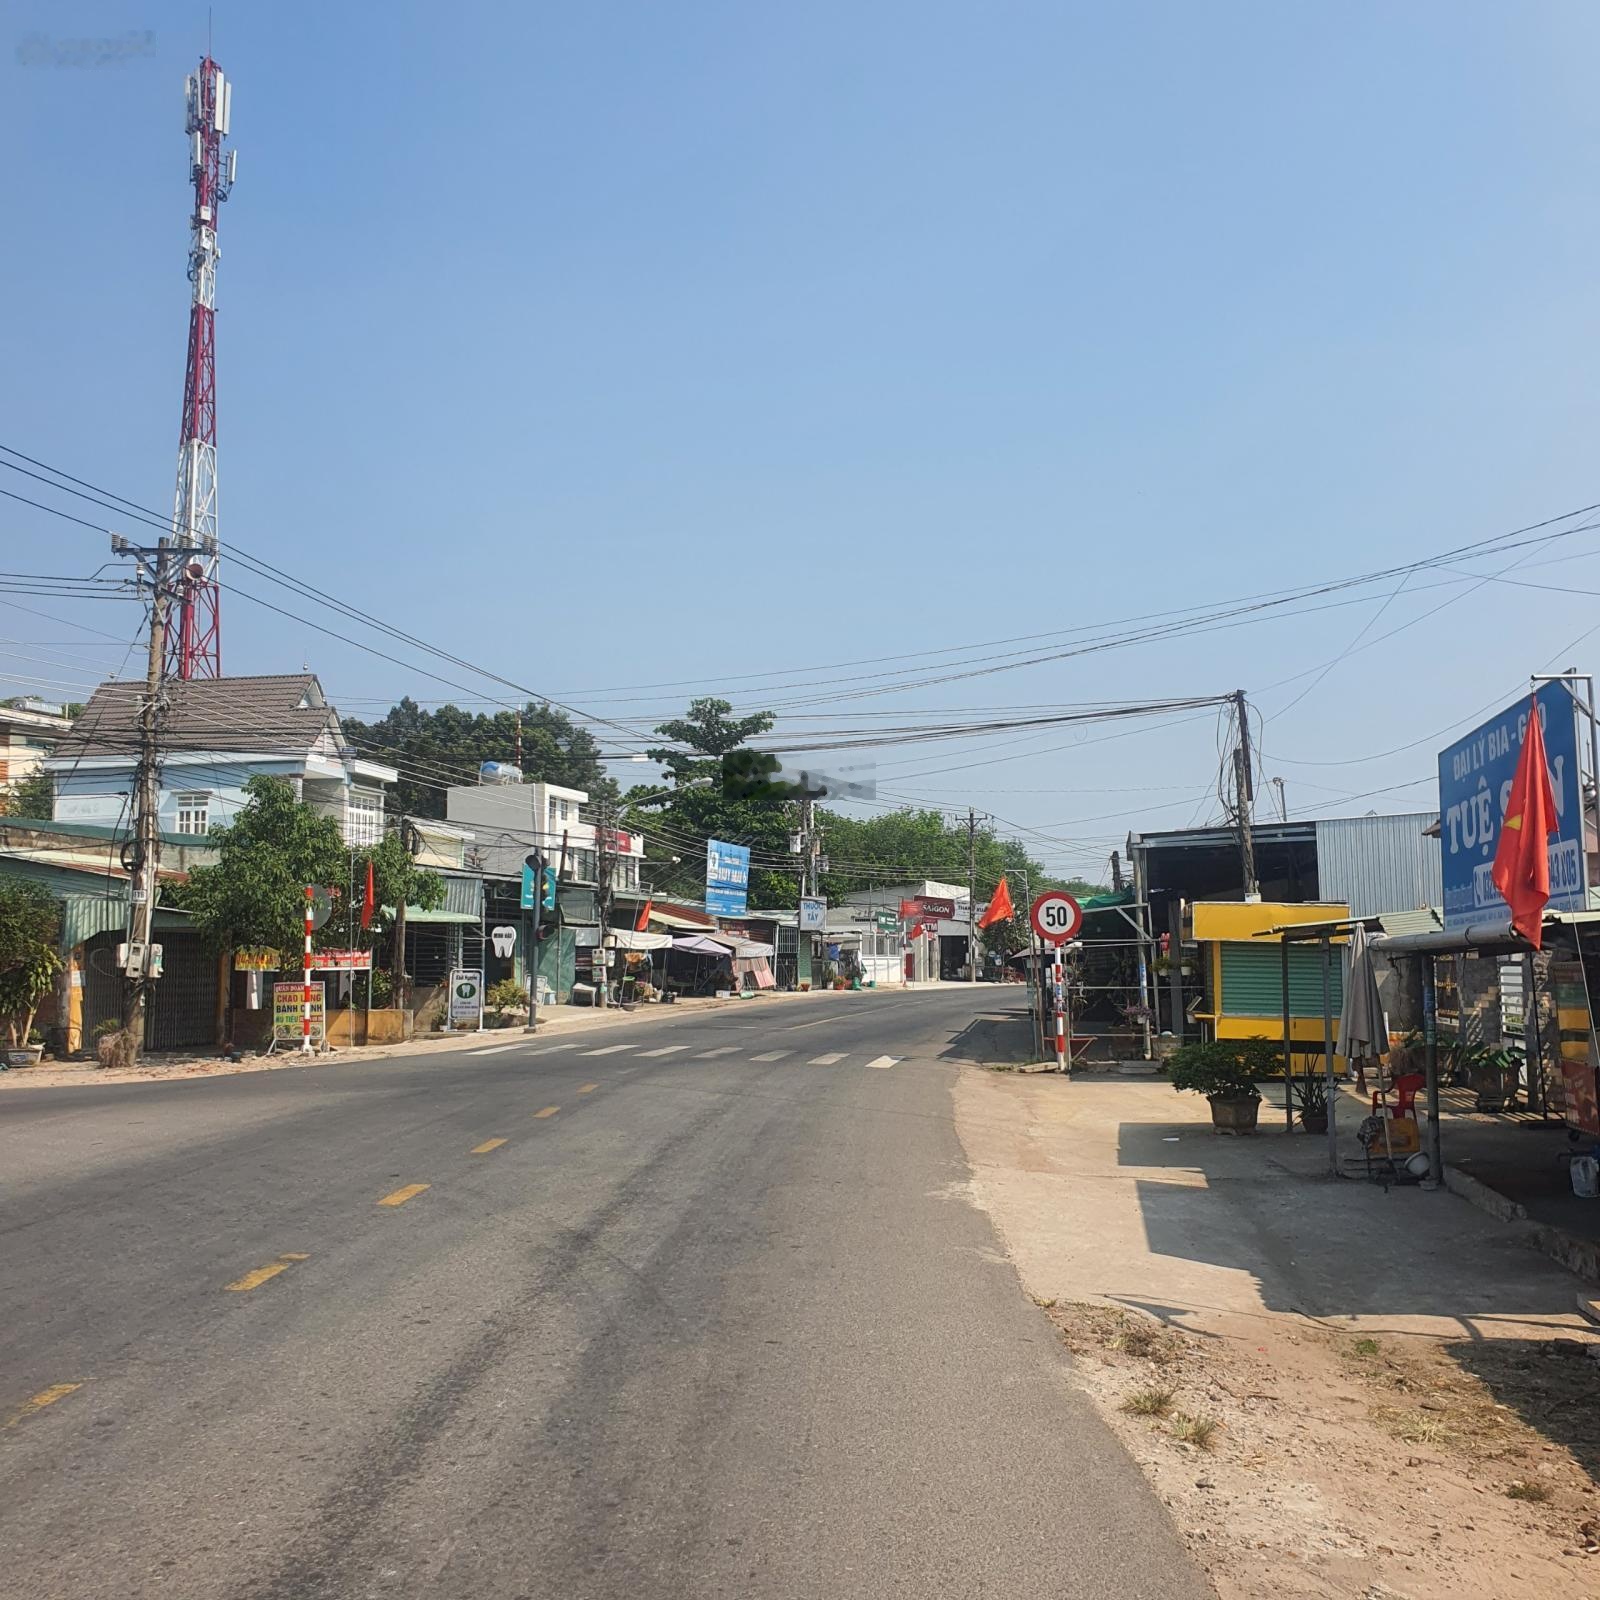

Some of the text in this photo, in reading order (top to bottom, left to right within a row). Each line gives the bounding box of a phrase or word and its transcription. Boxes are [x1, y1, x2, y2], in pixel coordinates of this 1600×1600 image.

[1446, 775, 1494, 856] TUỆ
[1045, 906, 1067, 927] 50
[300, 993, 322, 1002] LNG
